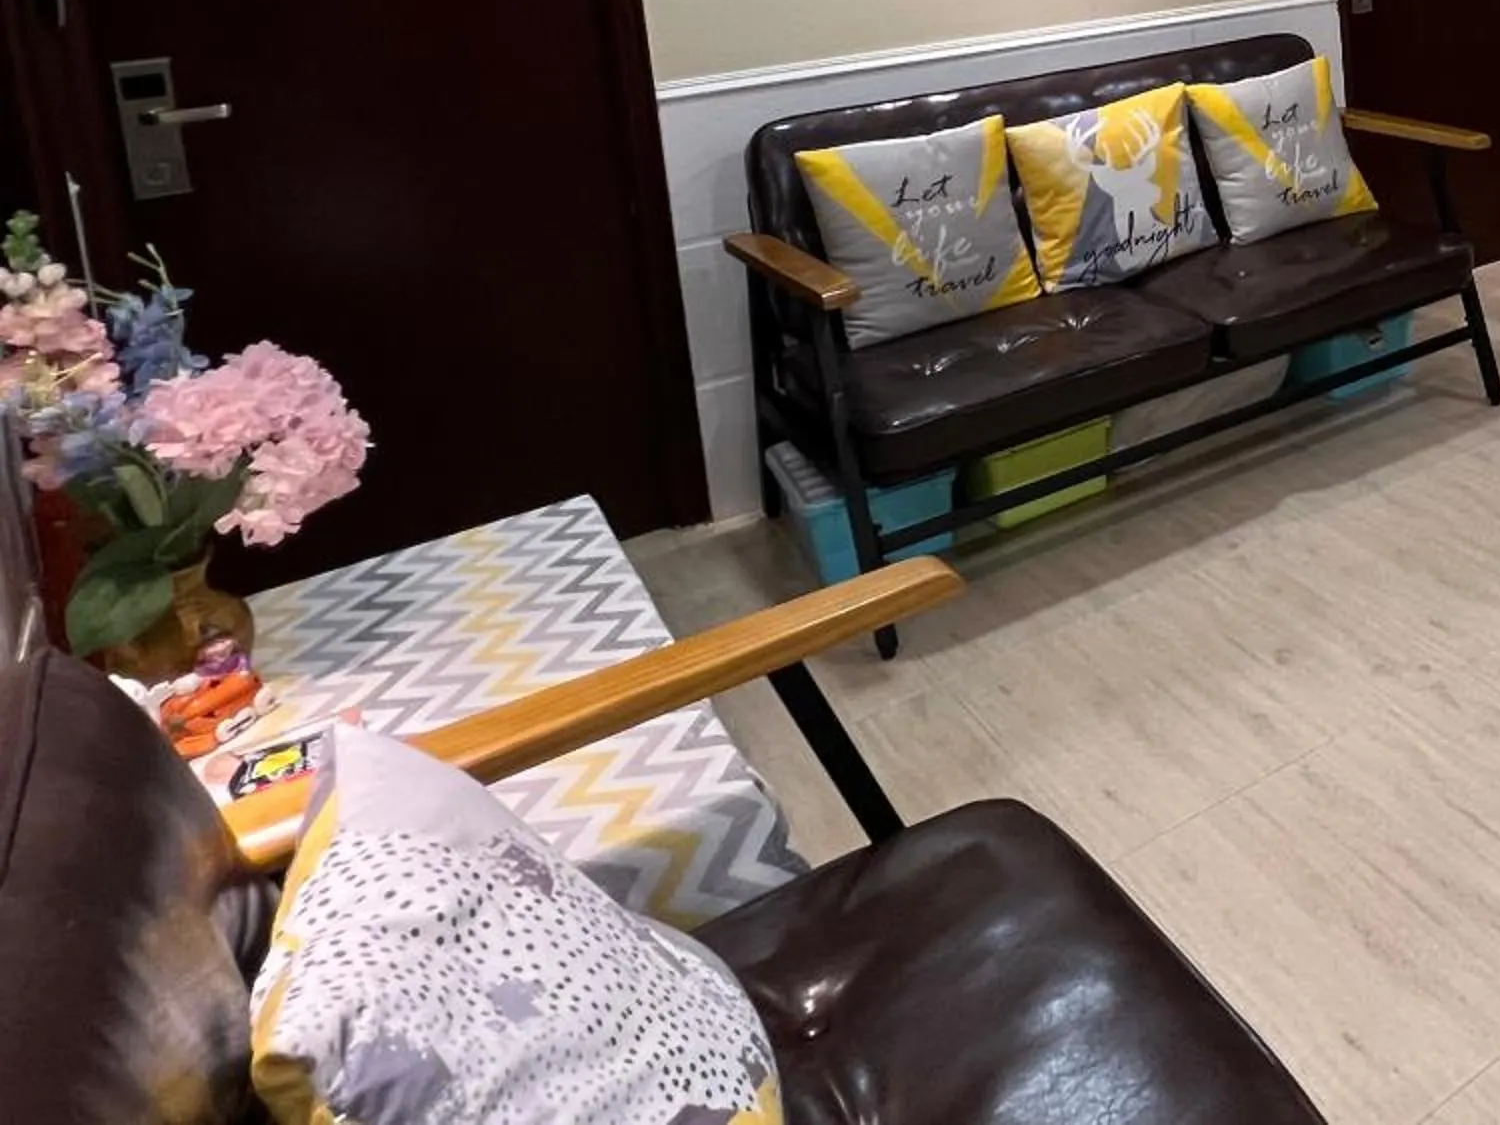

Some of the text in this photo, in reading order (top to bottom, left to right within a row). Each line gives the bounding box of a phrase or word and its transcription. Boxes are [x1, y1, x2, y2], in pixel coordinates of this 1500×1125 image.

[1262, 103, 1299, 130] Let
[890, 175, 954, 208] Let
[1276, 168, 1339, 206] travel
[1077, 192, 1199, 285] goodnight
[904, 255, 997, 298] travel
